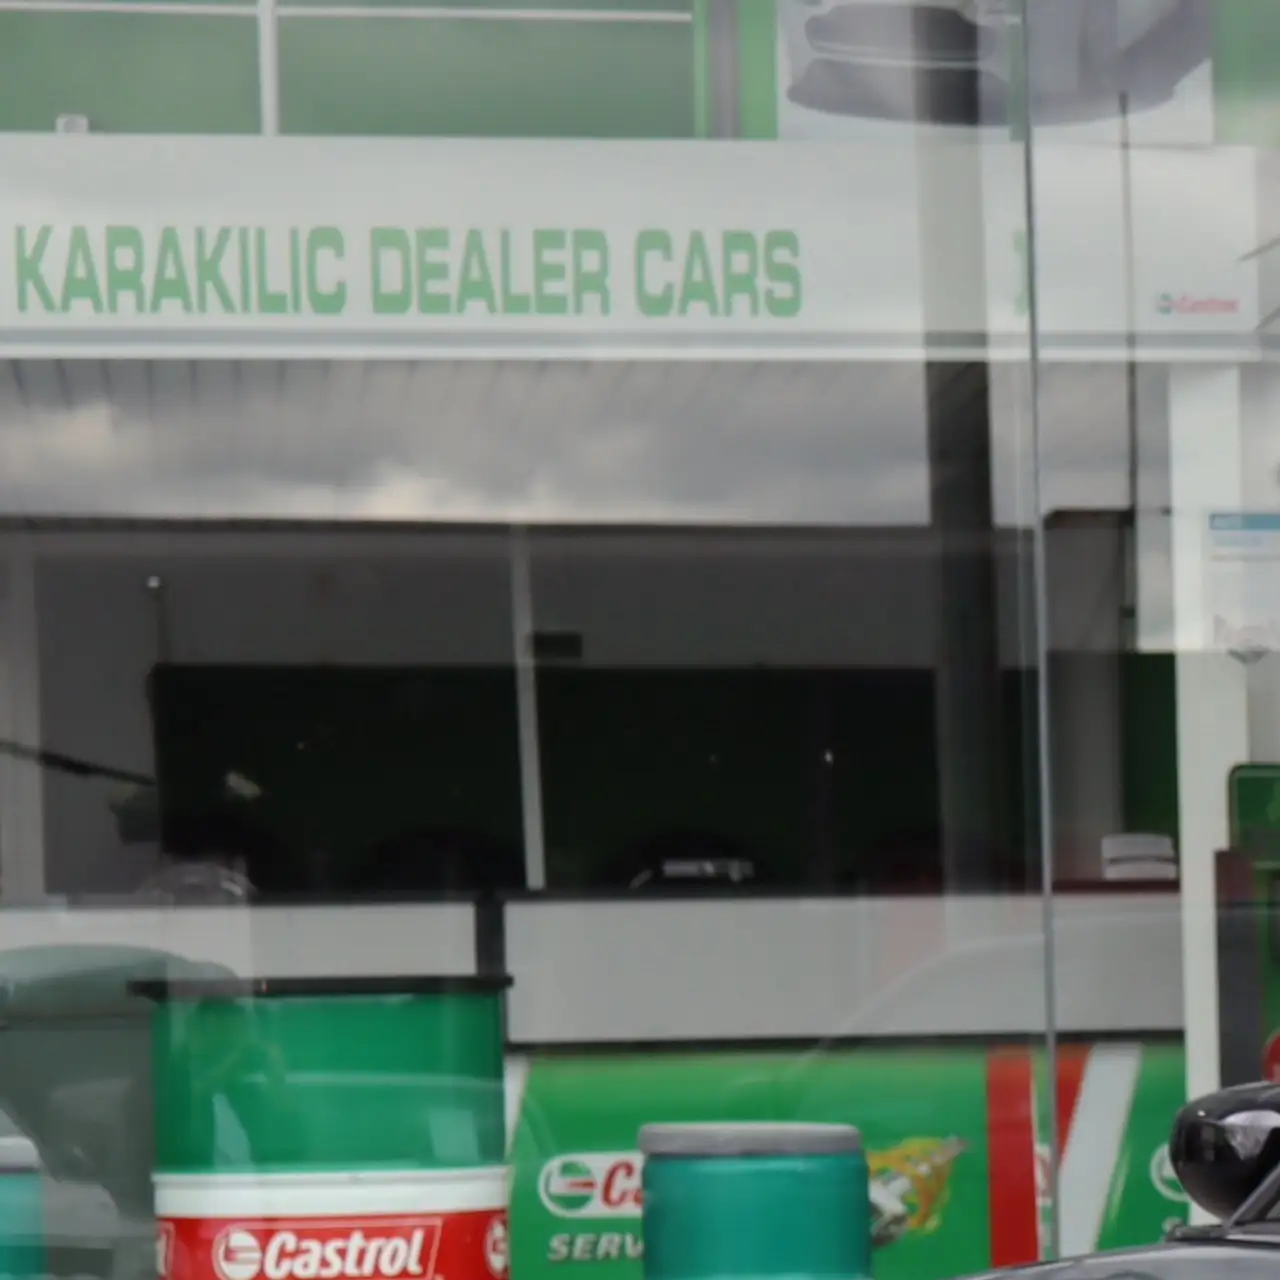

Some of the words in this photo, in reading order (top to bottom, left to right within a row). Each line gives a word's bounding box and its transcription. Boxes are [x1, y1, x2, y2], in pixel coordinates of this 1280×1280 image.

[14, 224, 348, 315] KARAKILIC
[370, 227, 611, 316] DEALER
[634, 229, 803, 318] CARS
[264, 1228, 425, 1280] Castrol
